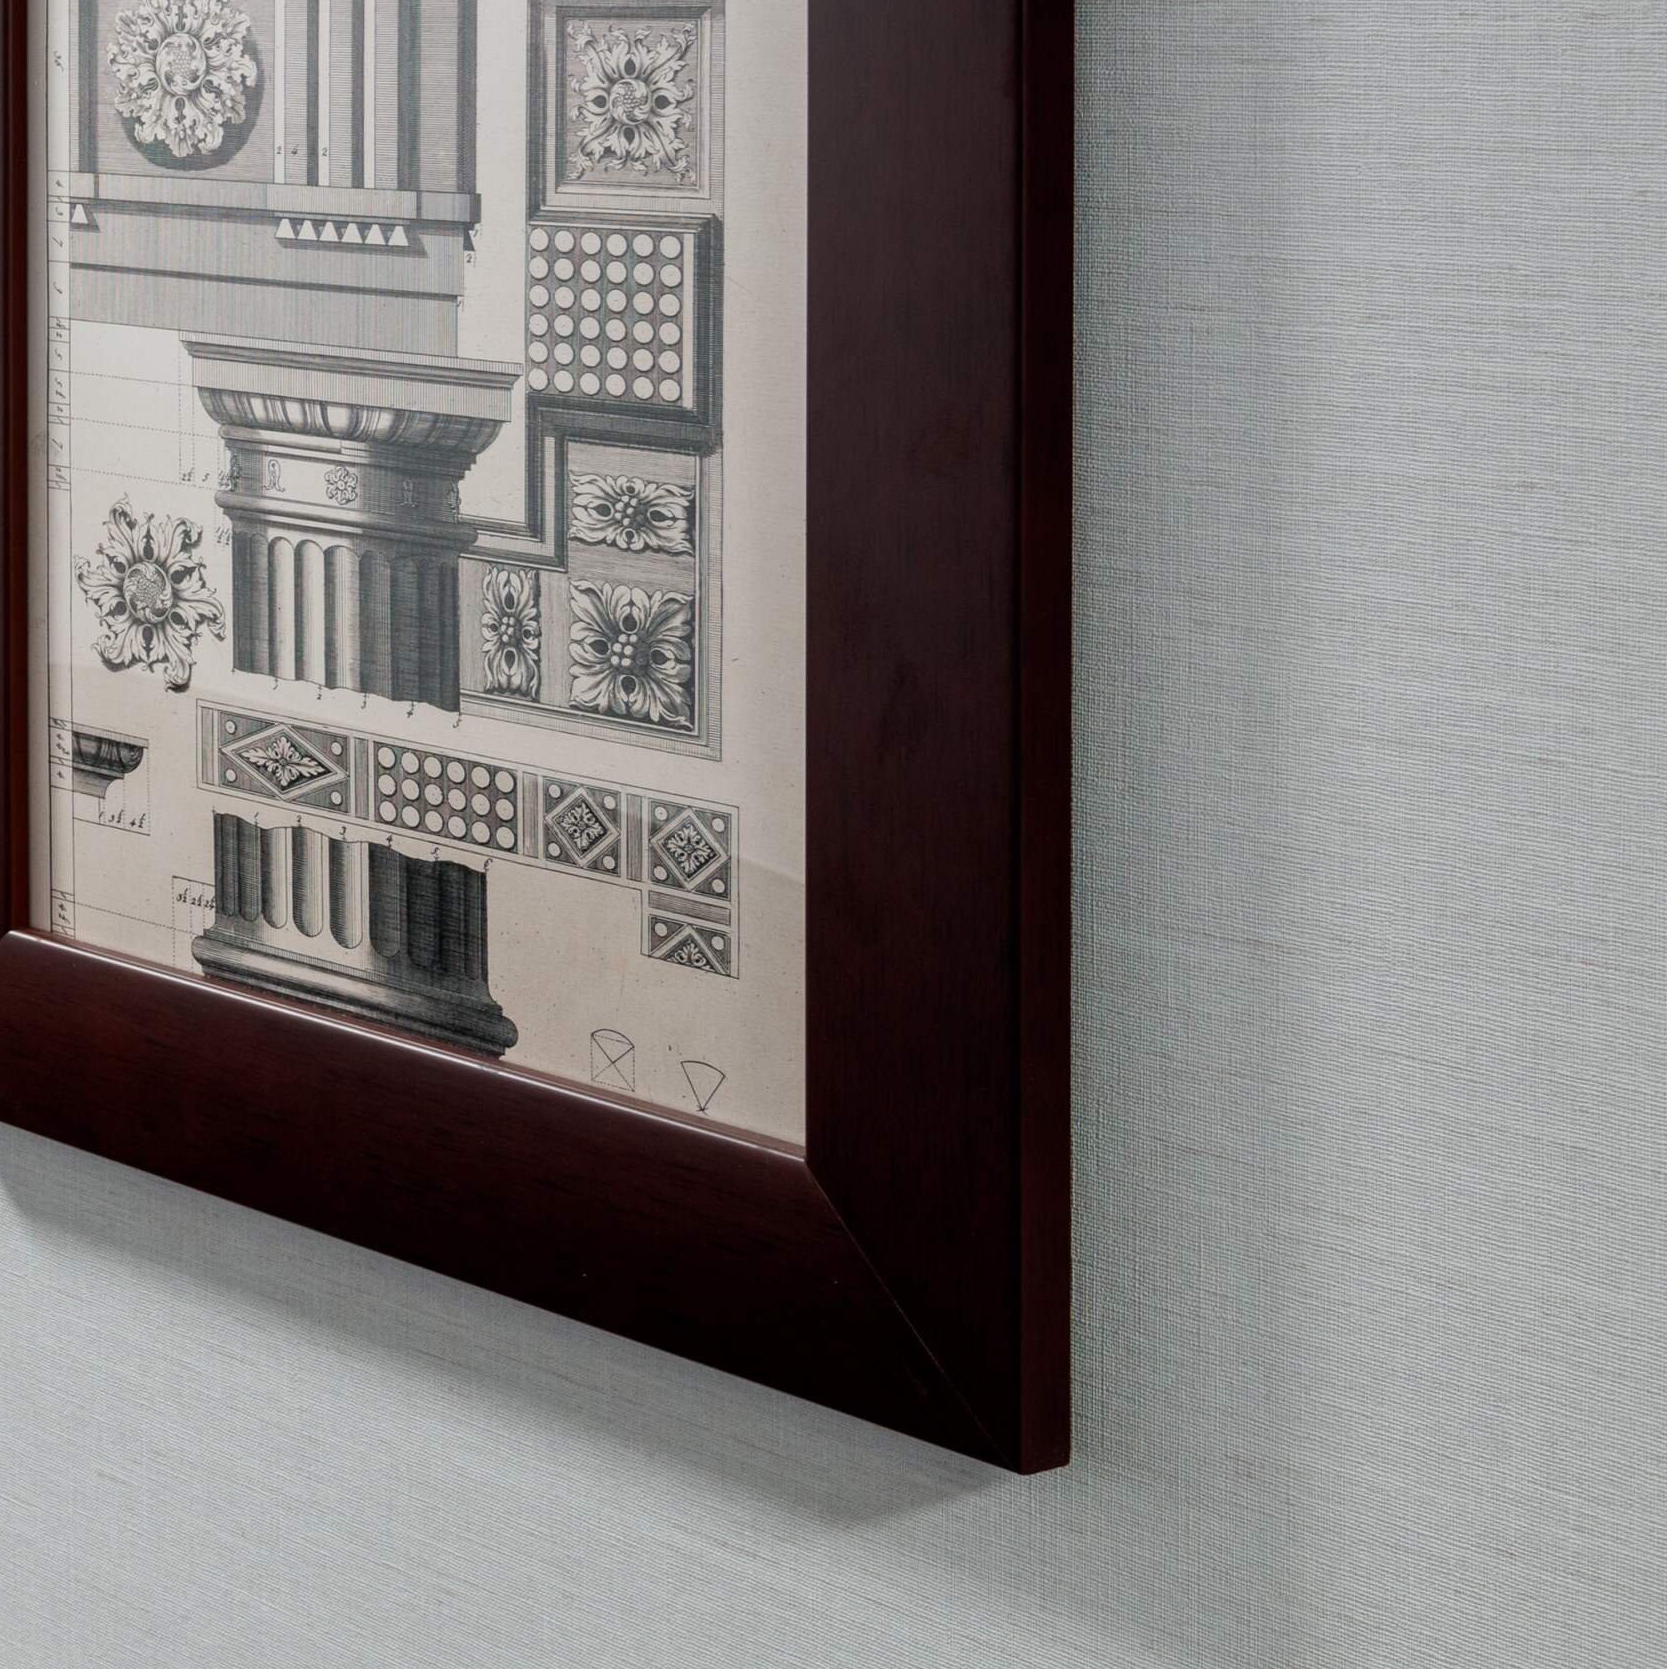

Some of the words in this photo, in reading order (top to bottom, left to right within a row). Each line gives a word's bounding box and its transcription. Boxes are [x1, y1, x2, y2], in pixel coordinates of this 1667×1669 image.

[276, 145, 282, 155] 2
[321, 147, 328, 157] 2
[465, 252, 473, 263] 2
